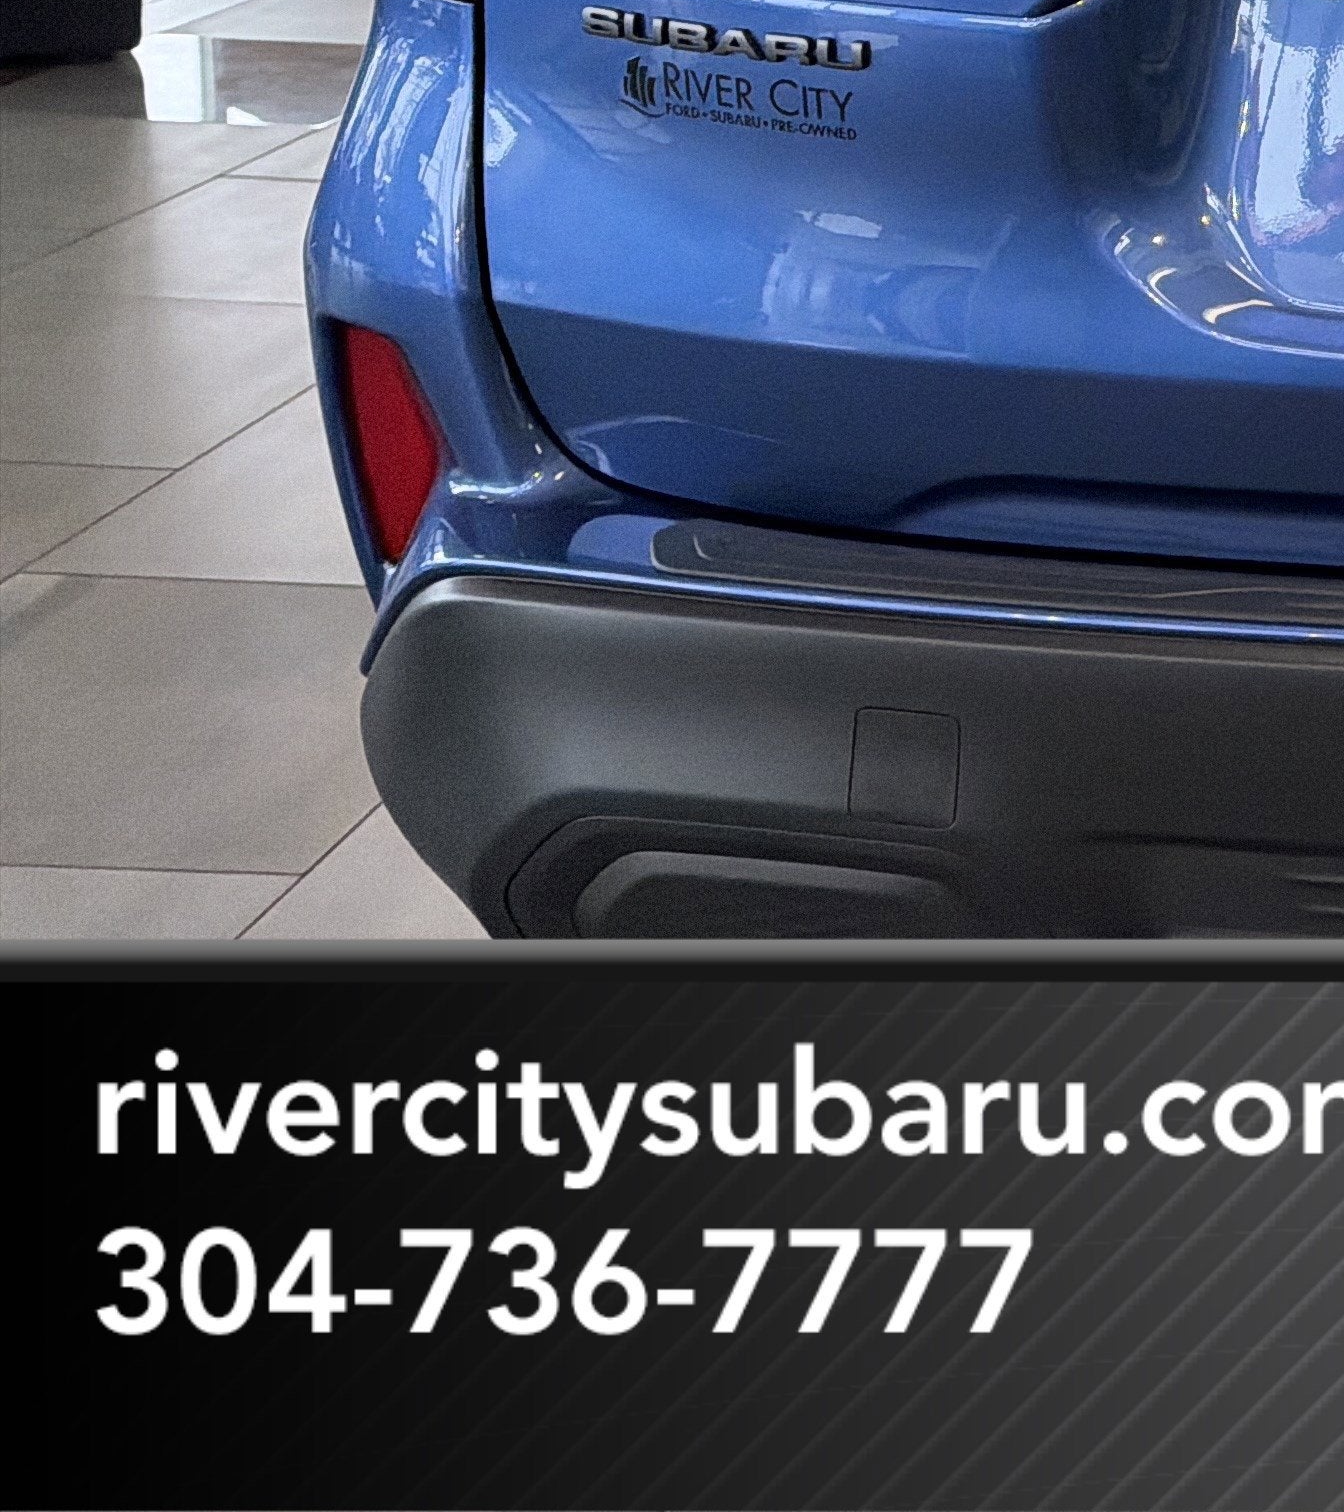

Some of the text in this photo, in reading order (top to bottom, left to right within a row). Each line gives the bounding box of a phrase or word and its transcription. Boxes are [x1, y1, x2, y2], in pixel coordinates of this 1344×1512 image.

[581, 5, 873, 71] SUBARU
[662, 61, 854, 123] RIVER CITY
[665, 102, 858, 141] FORD SUBARU PRE-OWNED
